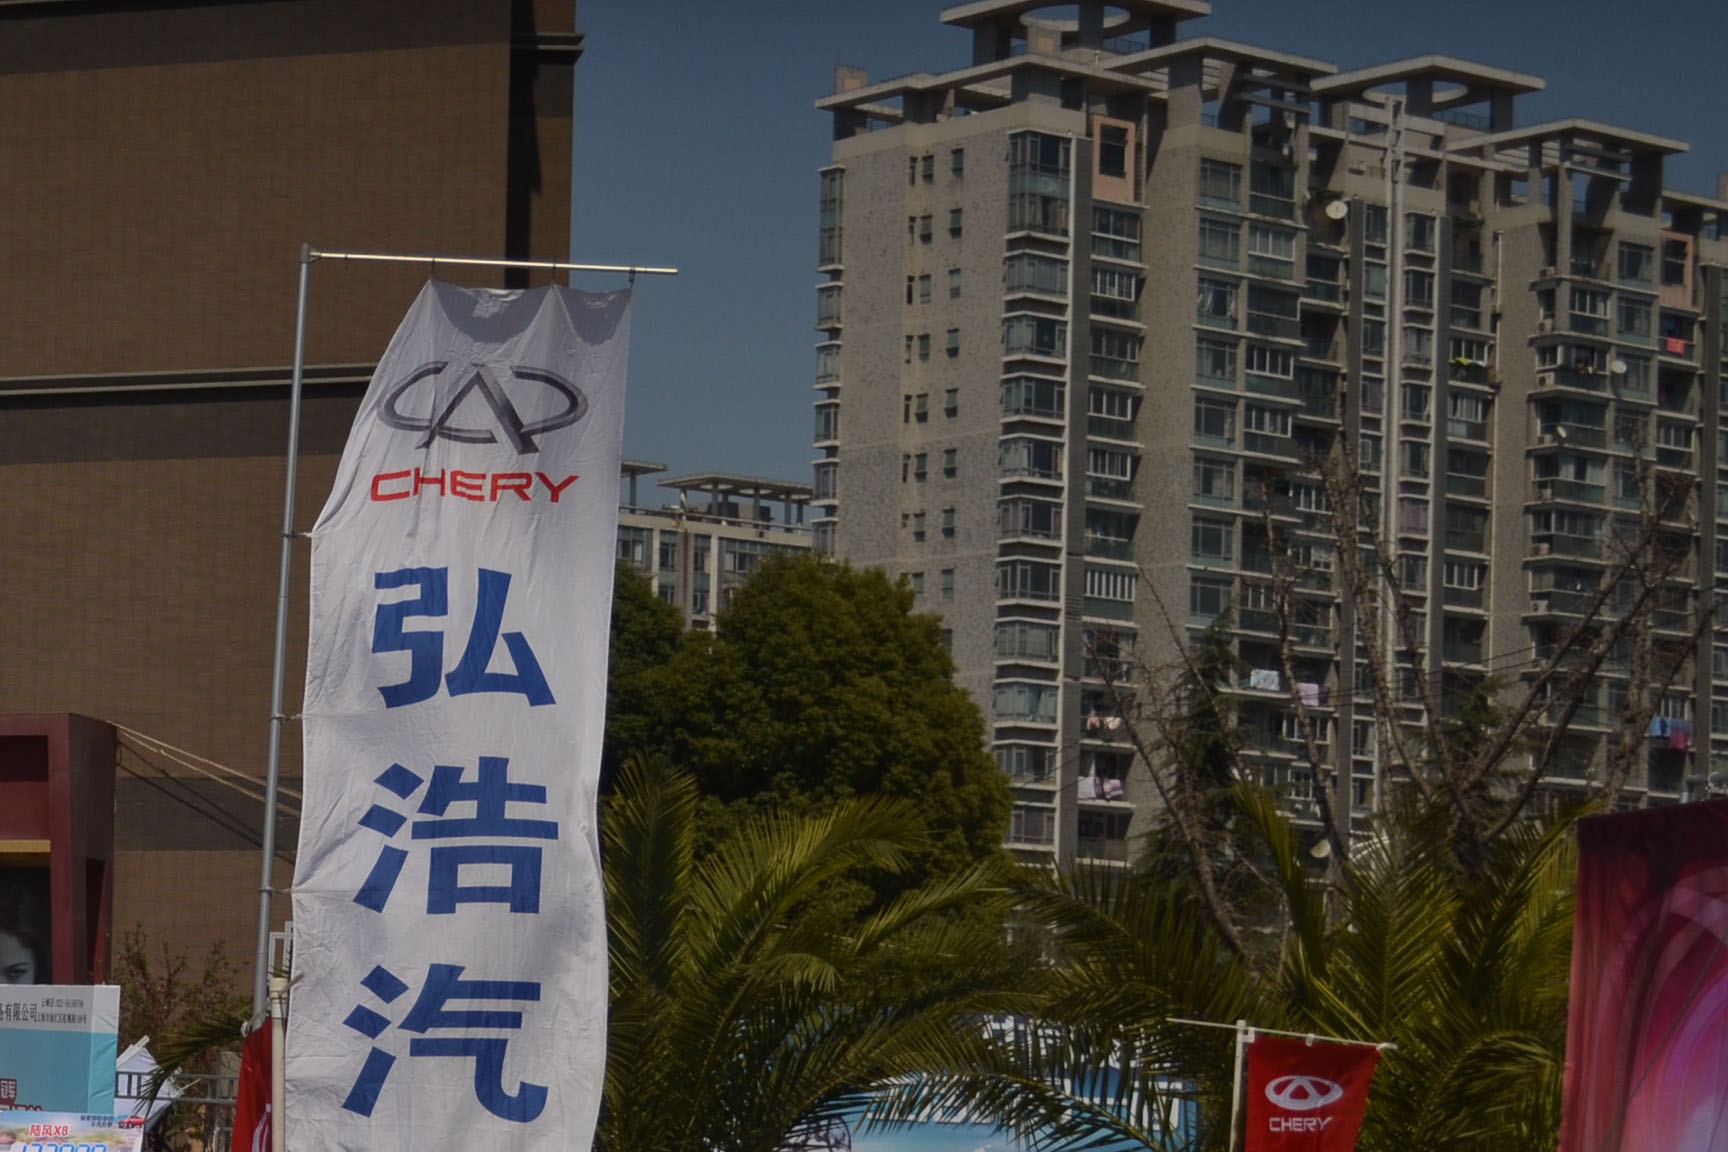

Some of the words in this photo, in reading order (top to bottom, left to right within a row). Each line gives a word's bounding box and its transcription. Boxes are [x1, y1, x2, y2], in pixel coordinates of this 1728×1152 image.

[371, 467, 580, 503] CHERY
[29, 1124, 69, 1137] 陆风X8
[1269, 1116, 1332, 1133] CHERY
